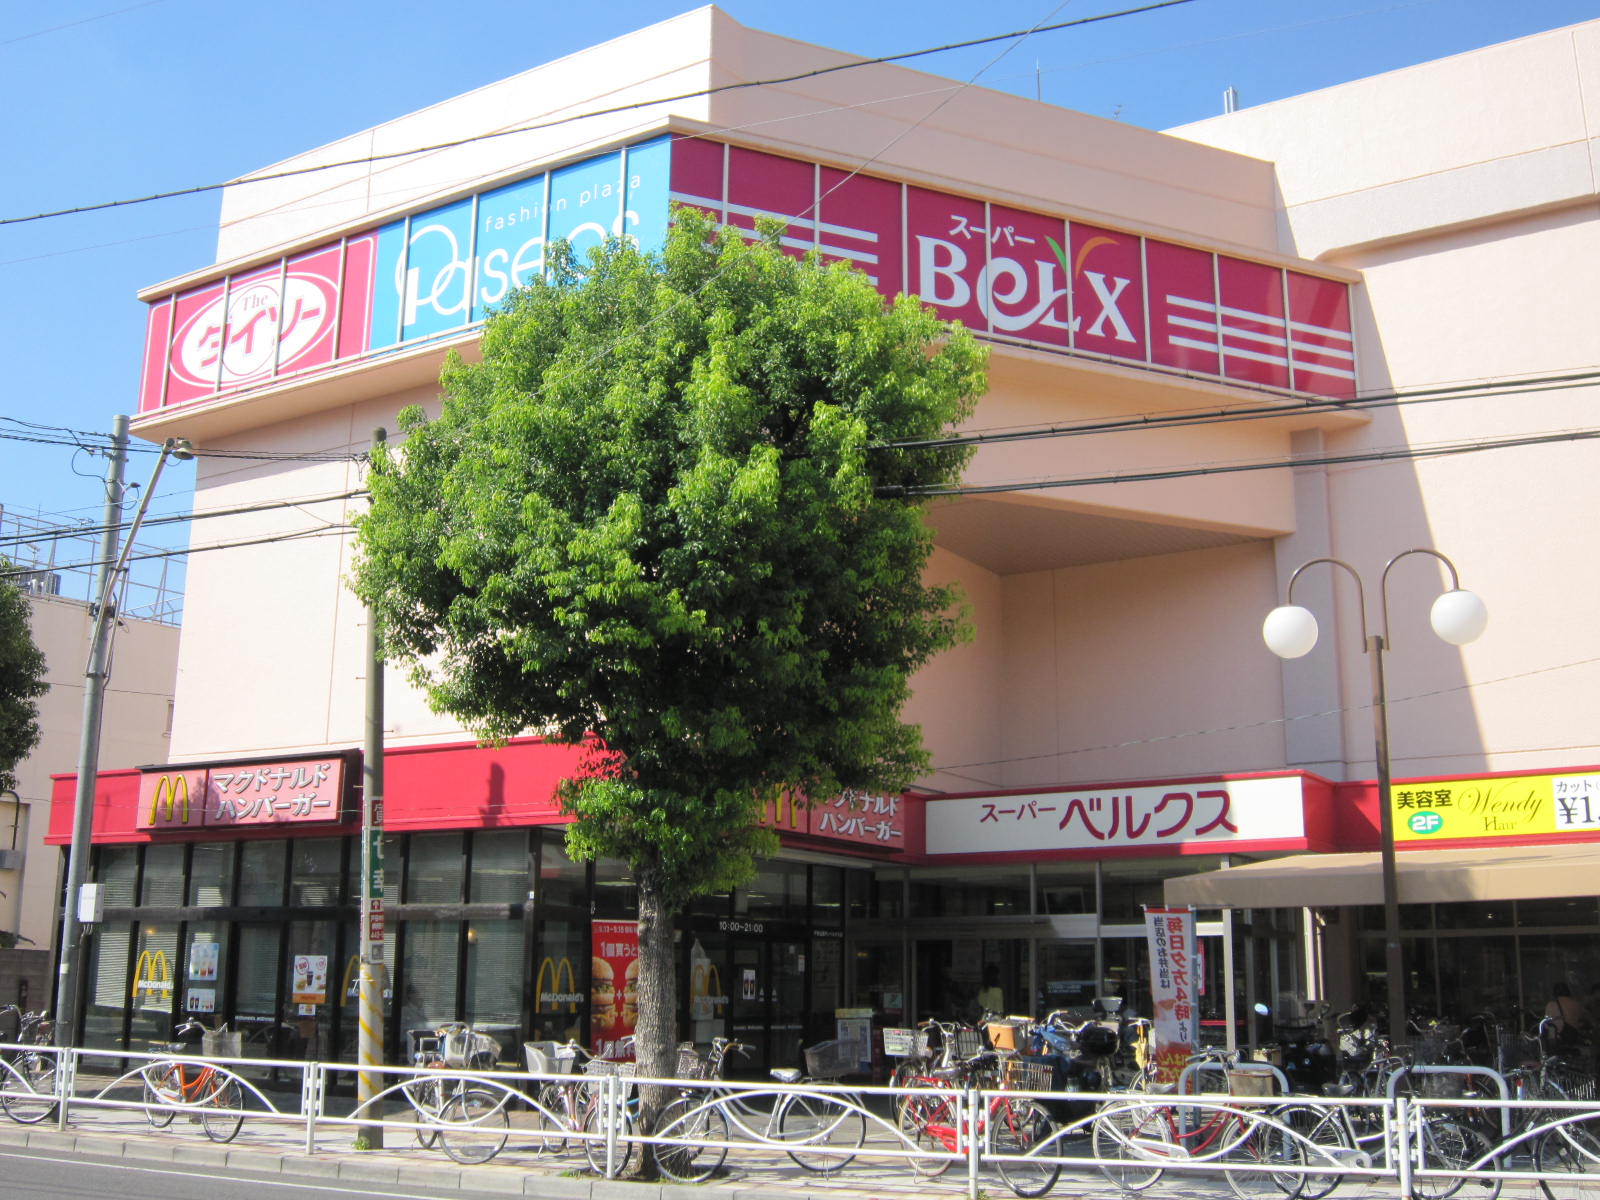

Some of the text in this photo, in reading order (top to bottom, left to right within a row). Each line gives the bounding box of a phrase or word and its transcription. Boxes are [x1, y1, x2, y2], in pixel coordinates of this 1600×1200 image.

[949, 215, 1036, 246] スーパー
[242, 294, 269, 311] The
[213, 763, 331, 794] マクドナルド
[214, 792, 331, 821] ハンバーガー
[824, 790, 900, 817] クドナルド
[1397, 789, 1453, 811] 美容室
[1457, 781, 1543, 824] Wendy
[819, 812, 903, 841] ハンバーガー
[980, 790, 1238, 840] スーパー ベルクス
[1411, 814, 1441, 832] 2F
[1483, 816, 1517, 832] Hair
[540, 991, 585, 1003] McDonald's
